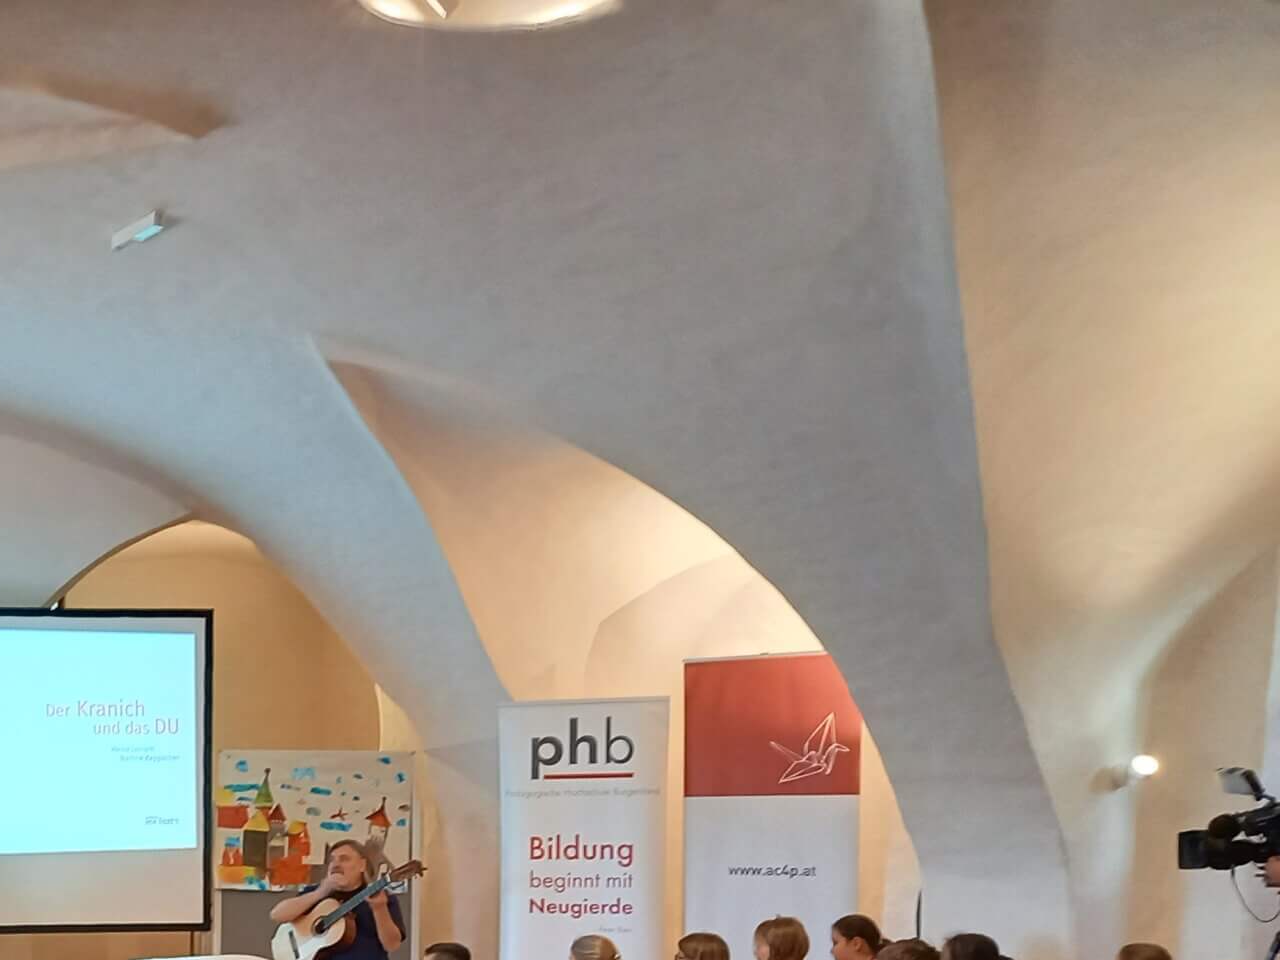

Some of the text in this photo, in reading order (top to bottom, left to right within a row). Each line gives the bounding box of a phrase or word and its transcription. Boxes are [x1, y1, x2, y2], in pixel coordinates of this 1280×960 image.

[45, 698, 146, 718] Der Kranich
[93, 717, 180, 736] und das DU
[530, 716, 634, 780] phb
[529, 834, 634, 868] Bildung
[529, 869, 633, 893] beginnt mit
[728, 864, 817, 879] www.ac4p.at
[528, 897, 634, 919] Neugierde
